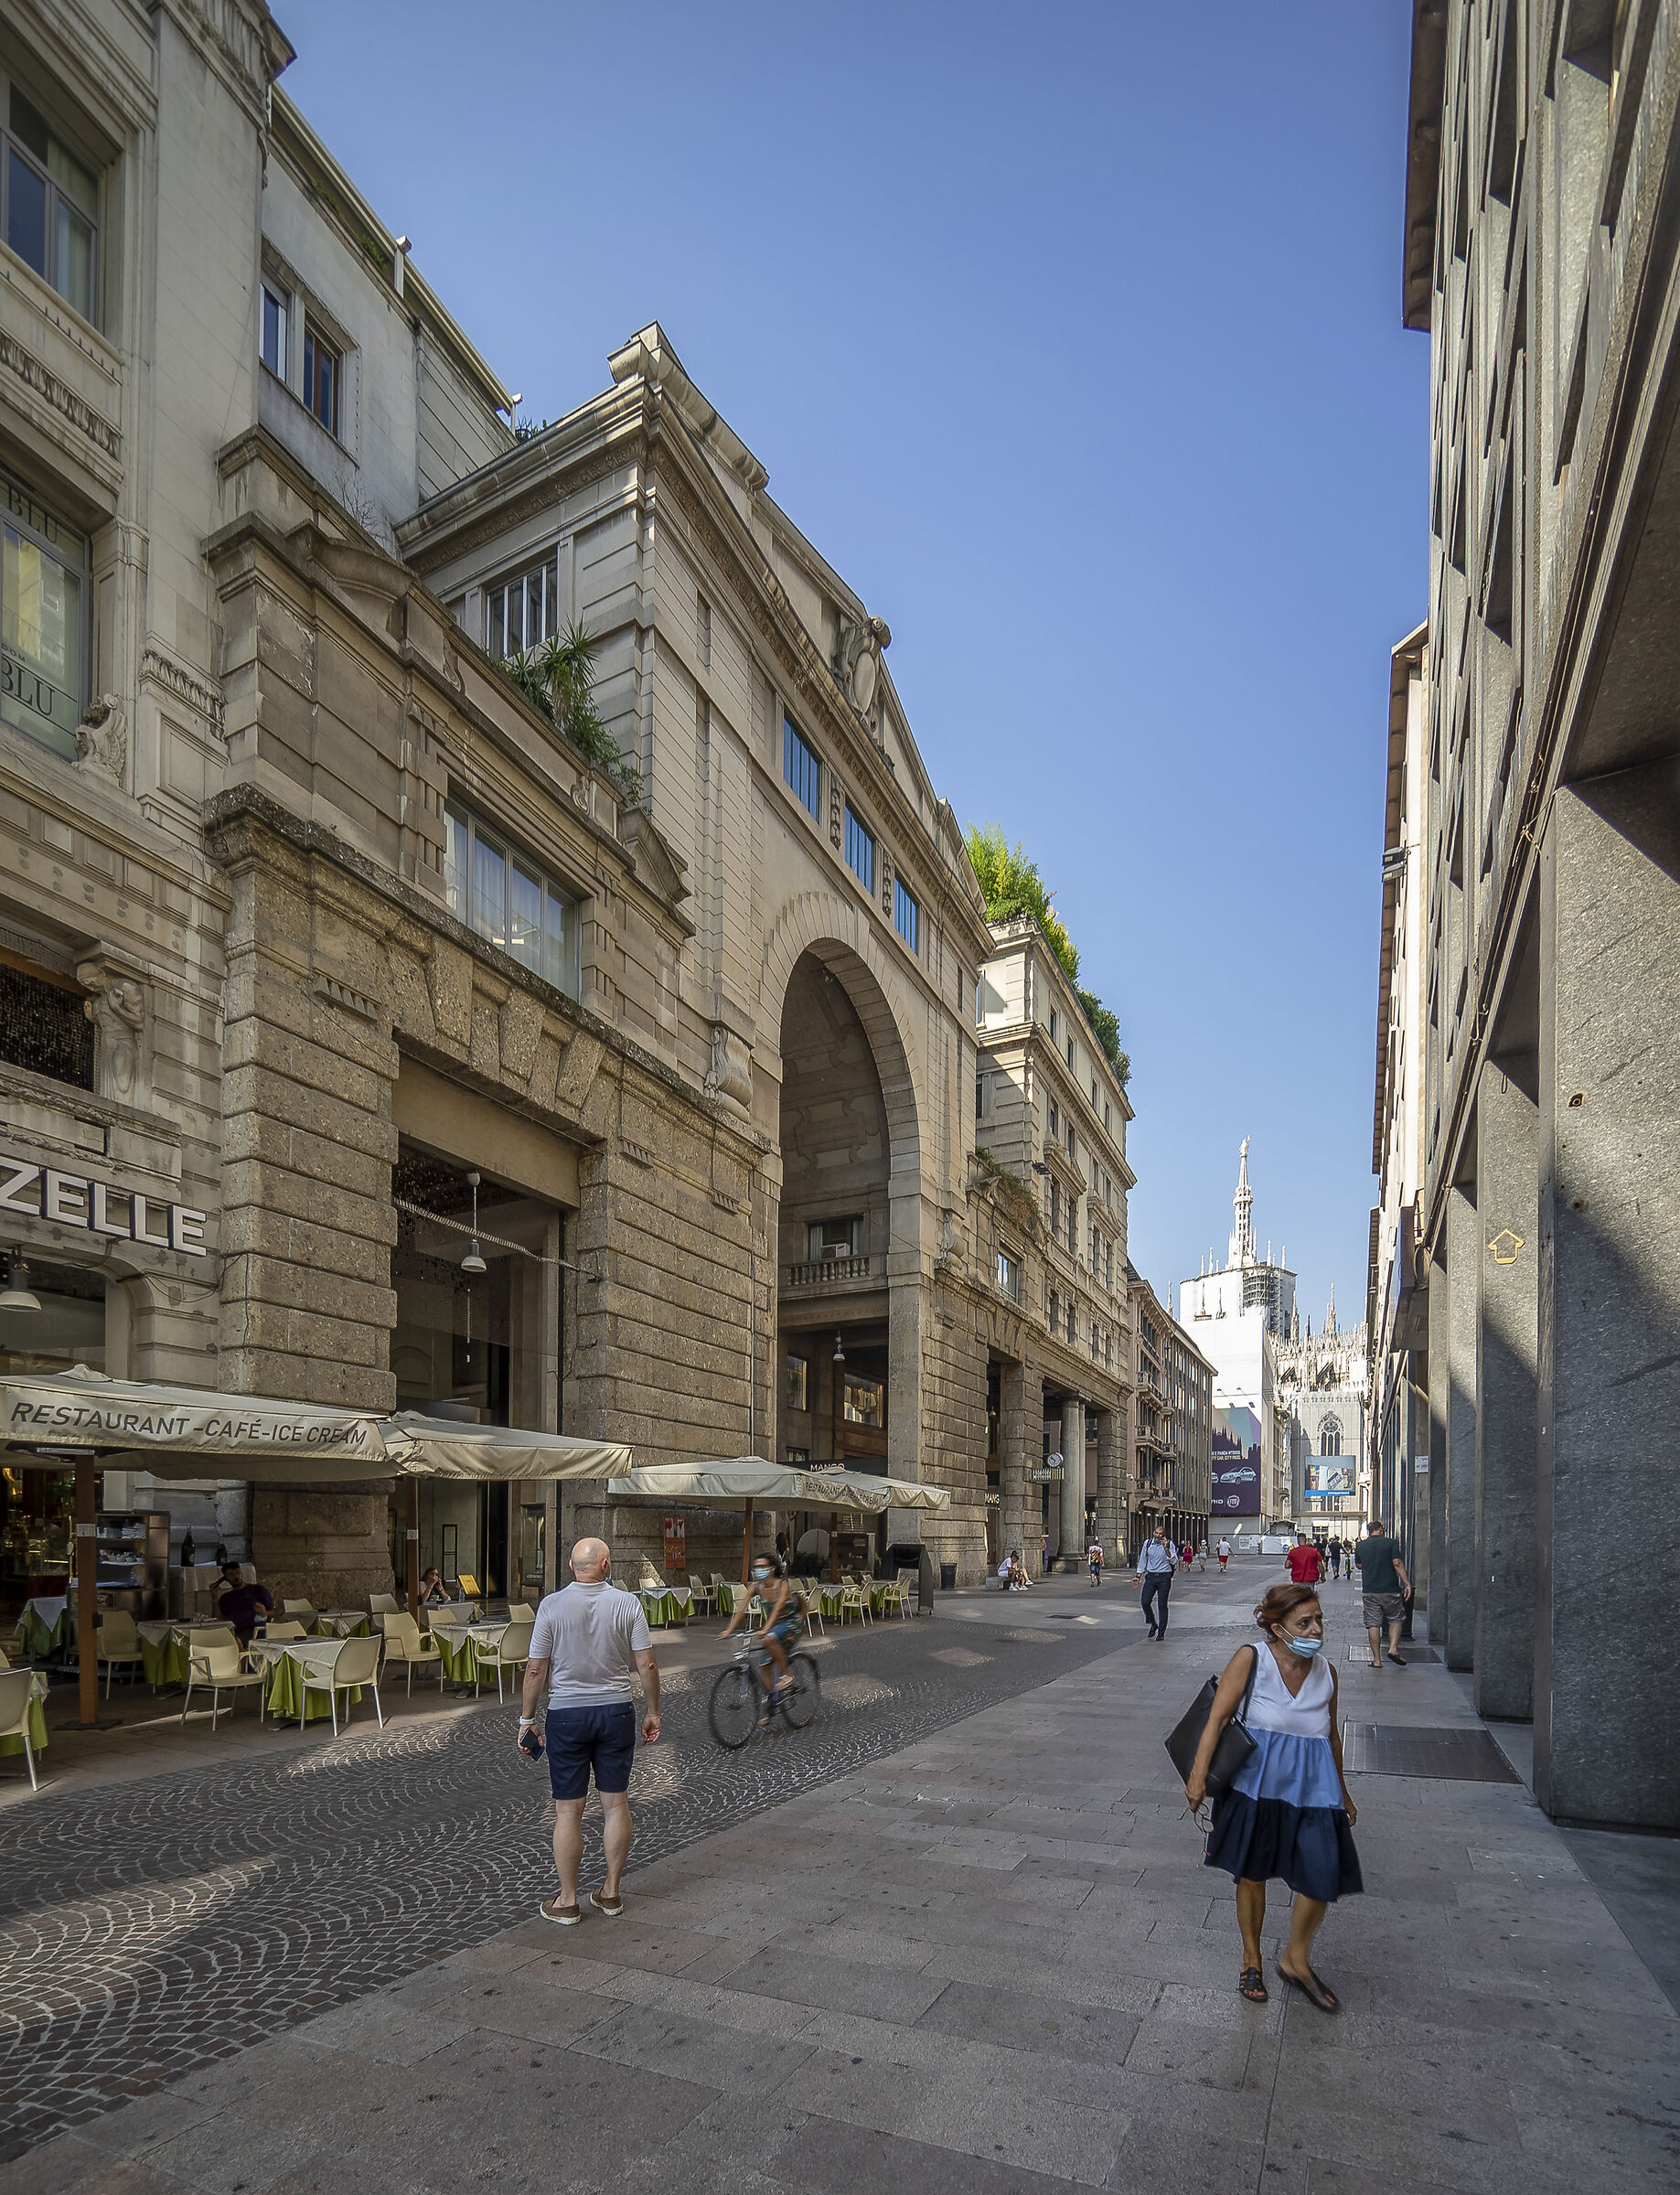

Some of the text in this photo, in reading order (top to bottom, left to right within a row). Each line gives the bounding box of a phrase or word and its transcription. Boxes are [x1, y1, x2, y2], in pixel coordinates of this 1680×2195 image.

[0, 1155, 208, 1258] ZELLE
[10, 1401, 191, 1435] RESTAURANT
[306, 1427, 368, 1446] CREAM
[805, 1483, 840, 1496] RESTAURANT
